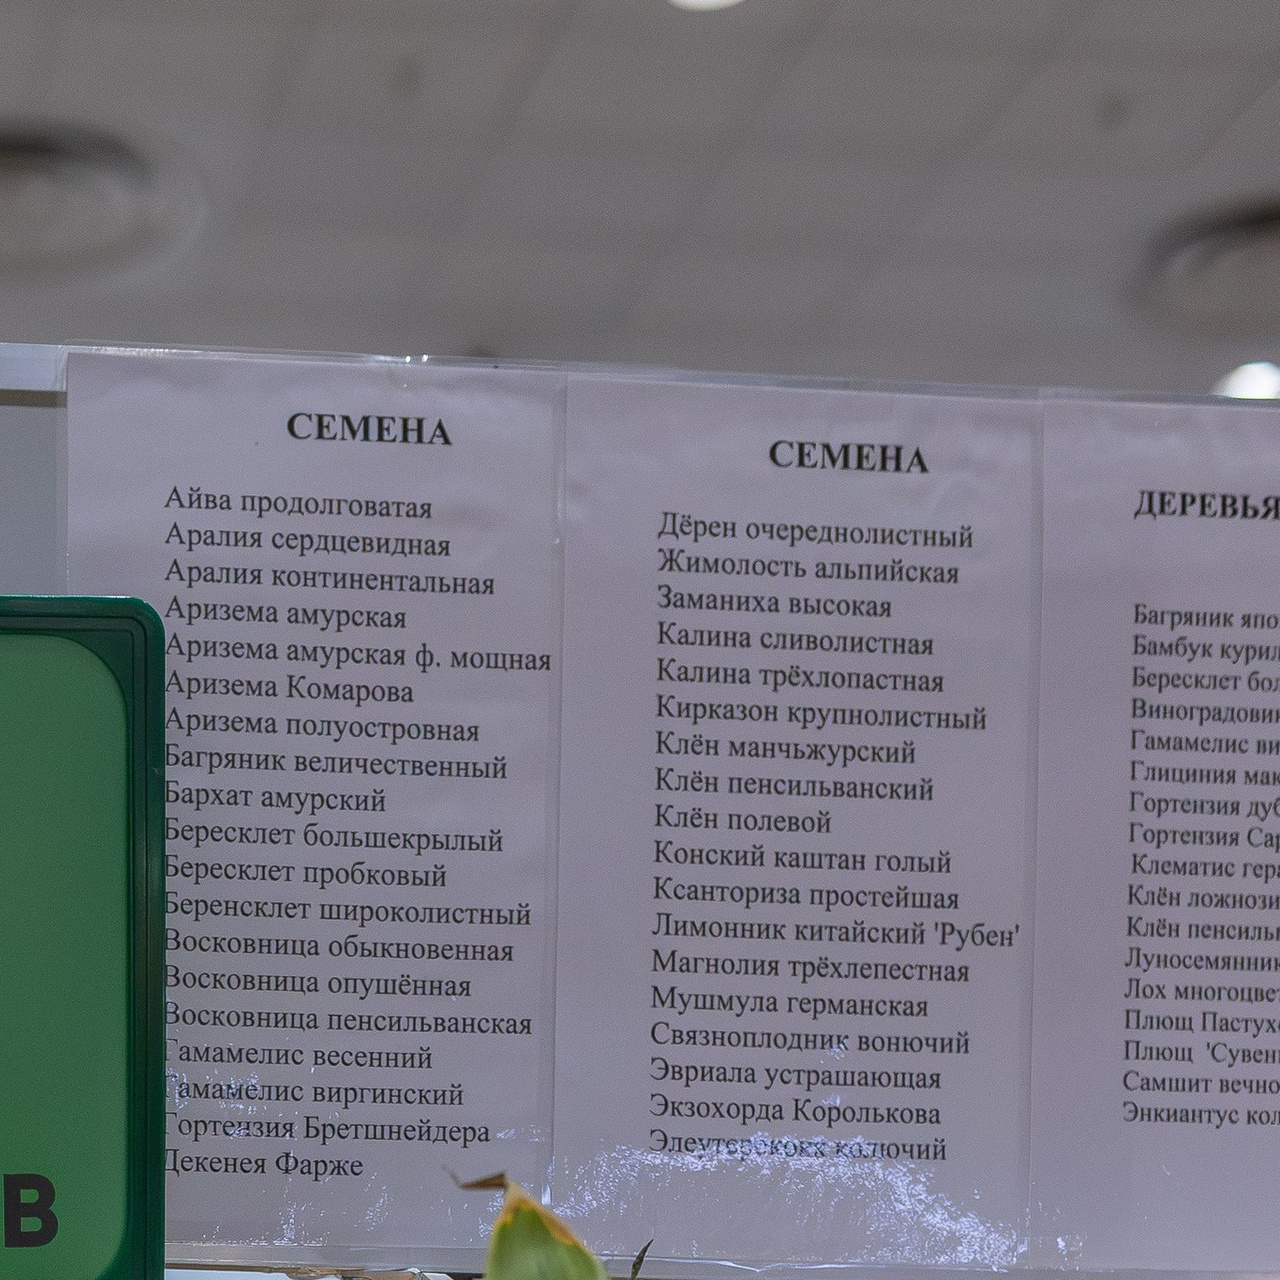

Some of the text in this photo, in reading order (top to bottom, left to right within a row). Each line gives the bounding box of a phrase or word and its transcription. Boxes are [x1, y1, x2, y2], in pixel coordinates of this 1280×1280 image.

[287, 413, 452, 446] СЕМЕНА
[769, 440, 929, 473] СЕМЕНА
[165, 486, 431, 519] Айва продолговатая
[1134, 490, 1280, 520] ДЕРЕВЬЯ
[165, 522, 450, 557] Аралия сердцевидная
[658, 512, 972, 548] Дёрен очереднолистный
[165, 559, 494, 595] Аралия континентальная
[658, 548, 958, 583] Жимолость альпийская
[165, 596, 406, 632] Аризема амурская
[658, 584, 891, 617] Заманиха высокая
[1135, 604, 1233, 630] Багряник
[165, 633, 550, 673] Аризема амурская ф. мощная
[658, 621, 933, 655] Калина сливолистная
[1133, 635, 1212, 662] Бамбук
[165, 670, 413, 707] Аризема Комарова
[658, 658, 943, 692] Калина трёхлопастная
[1133, 666, 1238, 693] Бересклет
[165, 707, 479, 745] Аризема полуостровная
[657, 694, 986, 730] Кирказон крупнолистный
[656, 731, 915, 768] Клён манчьжурский
[1131, 729, 1248, 753] Гамамелис
[165, 743, 506, 779] Багряник величественный
[1131, 760, 1236, 784] Глициния
[165, 780, 385, 815] Бархат амурский
[656, 767, 933, 801] Клён пенсильванский
[655, 804, 831, 833] Клён полевой
[1131, 791, 1240, 818] Гортензия
[165, 817, 502, 856] Бересклет большекрылый
[1130, 822, 1239, 849] Гортензия
[165, 854, 446, 889] Бересклет пробковый
[655, 840, 951, 873] Конский каштан голый
[1132, 853, 1234, 877] Клематис
[165, 891, 530, 927] Беренсклет широколистный
[654, 876, 958, 912] Ксанториза простейшая
[1128, 884, 1180, 906] Клён
[652, 912, 1019, 951] Лимонник китайский 'Рубен'
[1128, 916, 1179, 937] Клён
[165, 928, 513, 961] Восковница обыкновенная
[165, 965, 470, 1000] Восковница опушённая
[653, 949, 969, 984] Магнолия трёхлепестная
[652, 986, 927, 1020] Мушмула германская
[1124, 978, 1280, 1003] Лох многоцве
[165, 1002, 531, 1034] Восковница пенсильванская
[1125, 1009, 1194, 1032] Плющ
[651, 1022, 969, 1054] Связноплодник вонючий
[1125, 1040, 1280, 1068] Плющ 'Сувен
[314, 1047, 432, 1068] весенний
[651, 1057, 941, 1092] Эвриала устрашающая
[1123, 1071, 1212, 1092] Самшит
[313, 1084, 463, 1109] виргинский
[650, 1093, 941, 1128] Экзохорда Королькова
[304, 1116, 490, 1148] Бретшнейдера
[1123, 1102, 1238, 1129] Энкиантус
[165, 1149, 364, 1183] Декенея Фарже
